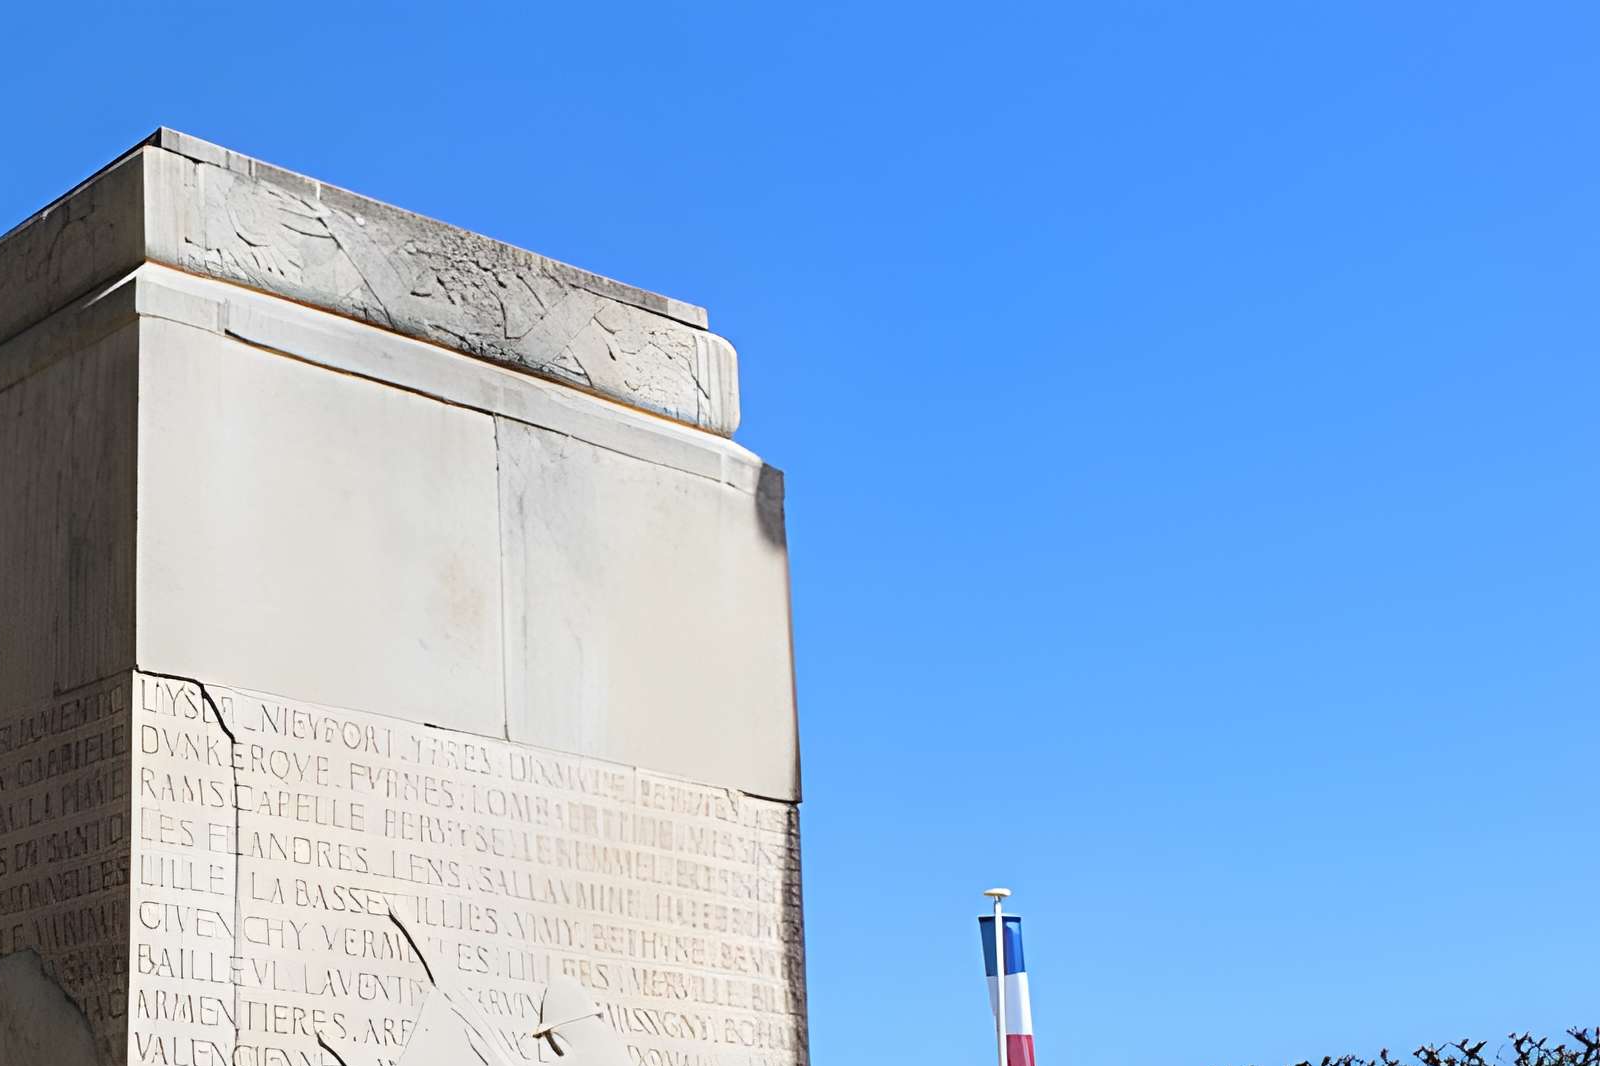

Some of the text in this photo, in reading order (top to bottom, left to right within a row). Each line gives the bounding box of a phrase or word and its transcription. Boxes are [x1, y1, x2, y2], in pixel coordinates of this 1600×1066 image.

[140, 806, 195, 848] LES
[140, 853, 225, 896] LILLE
[251, 871, 285, 906] LA
